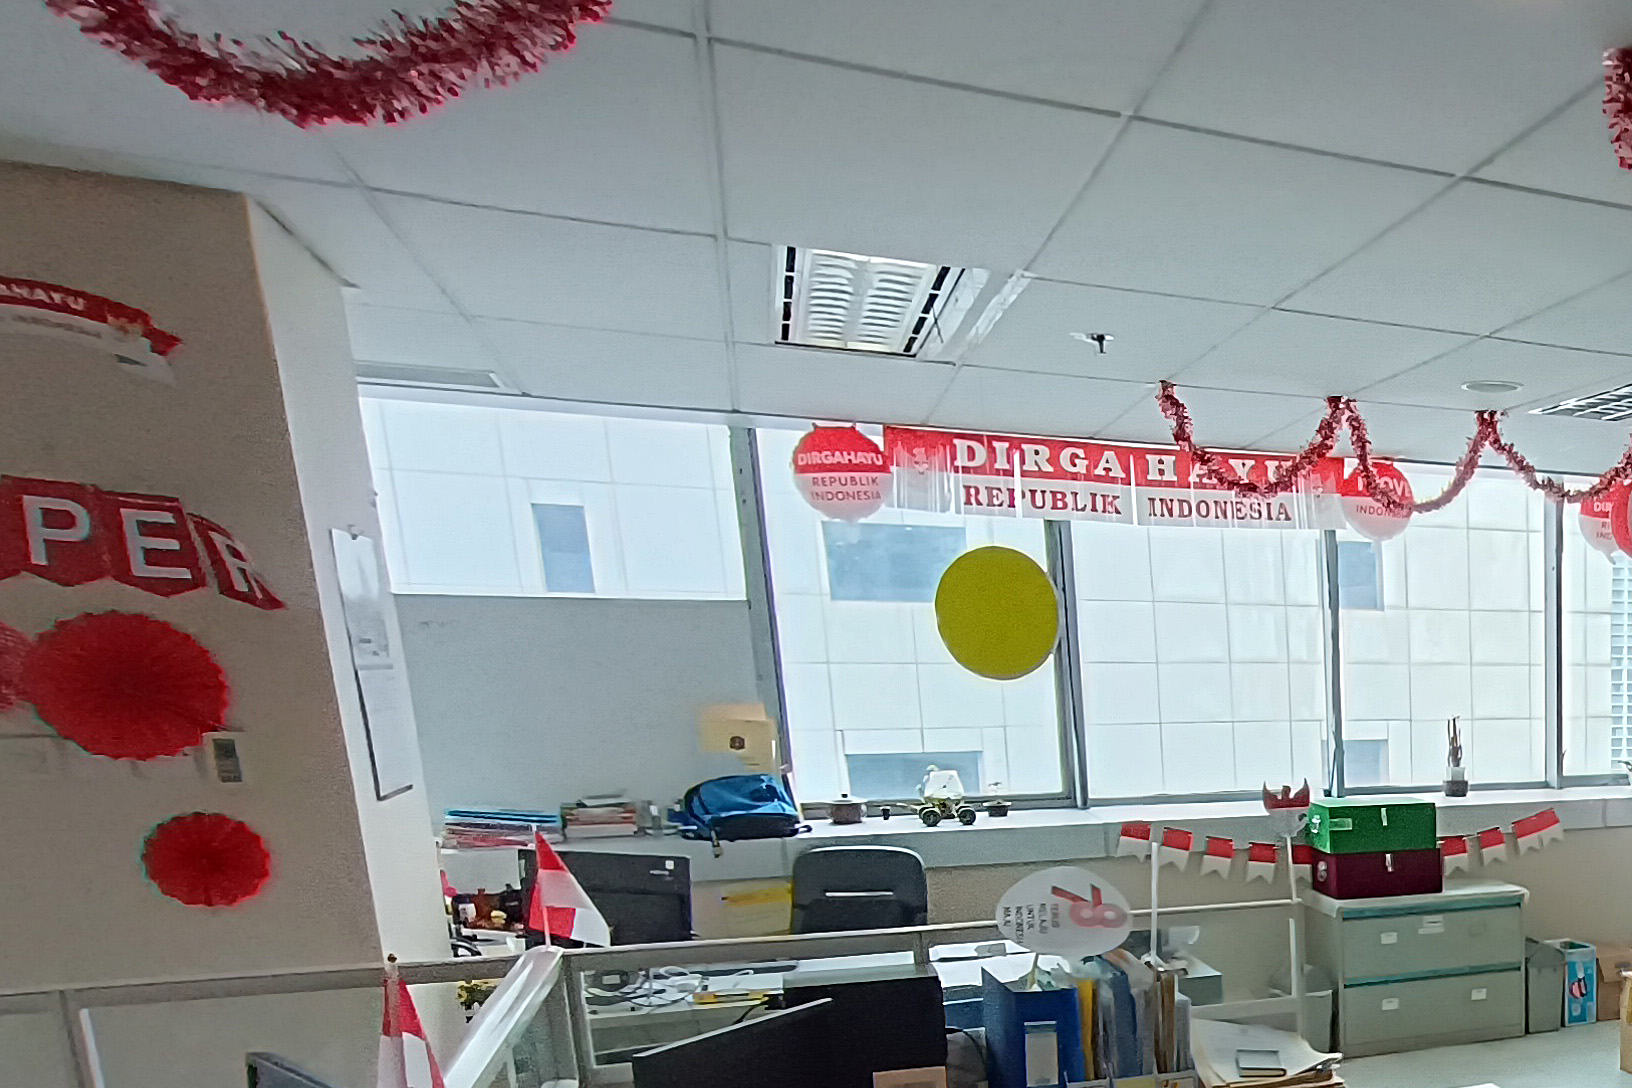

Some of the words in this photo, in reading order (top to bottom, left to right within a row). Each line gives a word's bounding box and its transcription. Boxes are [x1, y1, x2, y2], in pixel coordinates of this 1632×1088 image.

[797, 450, 884, 466] DIRGAHAYU
[812, 476, 879, 487] REPUBLIK
[811, 490, 882, 501] INDONESIA
[962, 485, 1122, 515] REPUBLIK
[1147, 497, 1292, 522] INDONESIA
